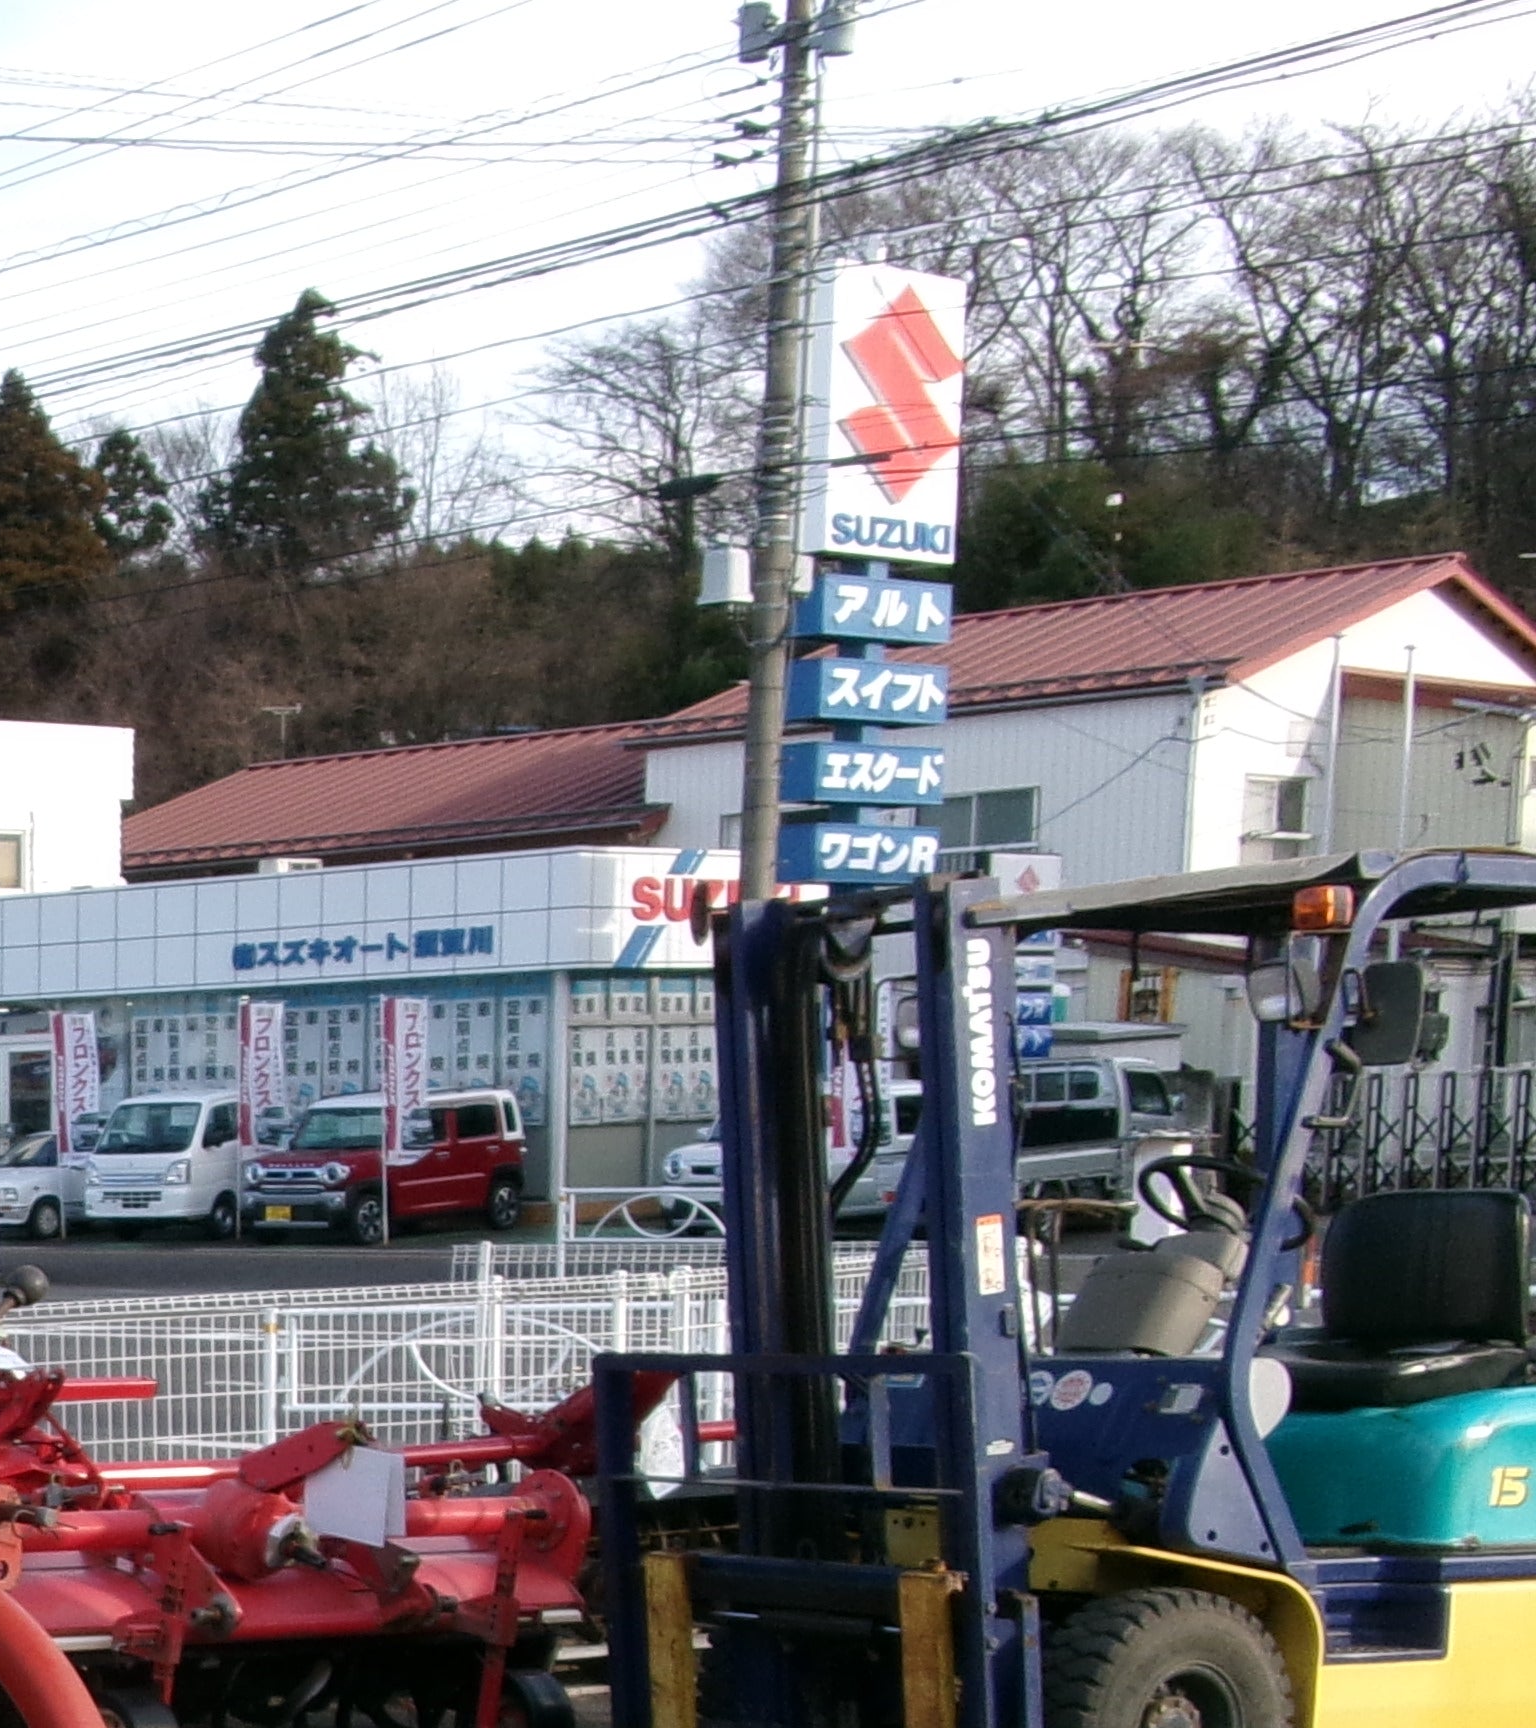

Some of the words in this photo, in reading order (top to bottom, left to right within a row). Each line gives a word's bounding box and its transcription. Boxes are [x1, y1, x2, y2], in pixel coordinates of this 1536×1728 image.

[831, 512, 950, 556] SUZUKI
[833, 584, 944, 632] アルト
[828, 667, 944, 712] スイフト
[822, 753, 944, 795] エスクード
[820, 832, 939, 873] ワゴンR
[964, 937, 996, 1126] KOMATSU
[72, 1027, 88, 1113] フロンクス
[254, 1018, 272, 1107] フロンクス
[404, 1014, 420, 1109] フロンクス
[1488, 1466, 1531, 1508] 15
